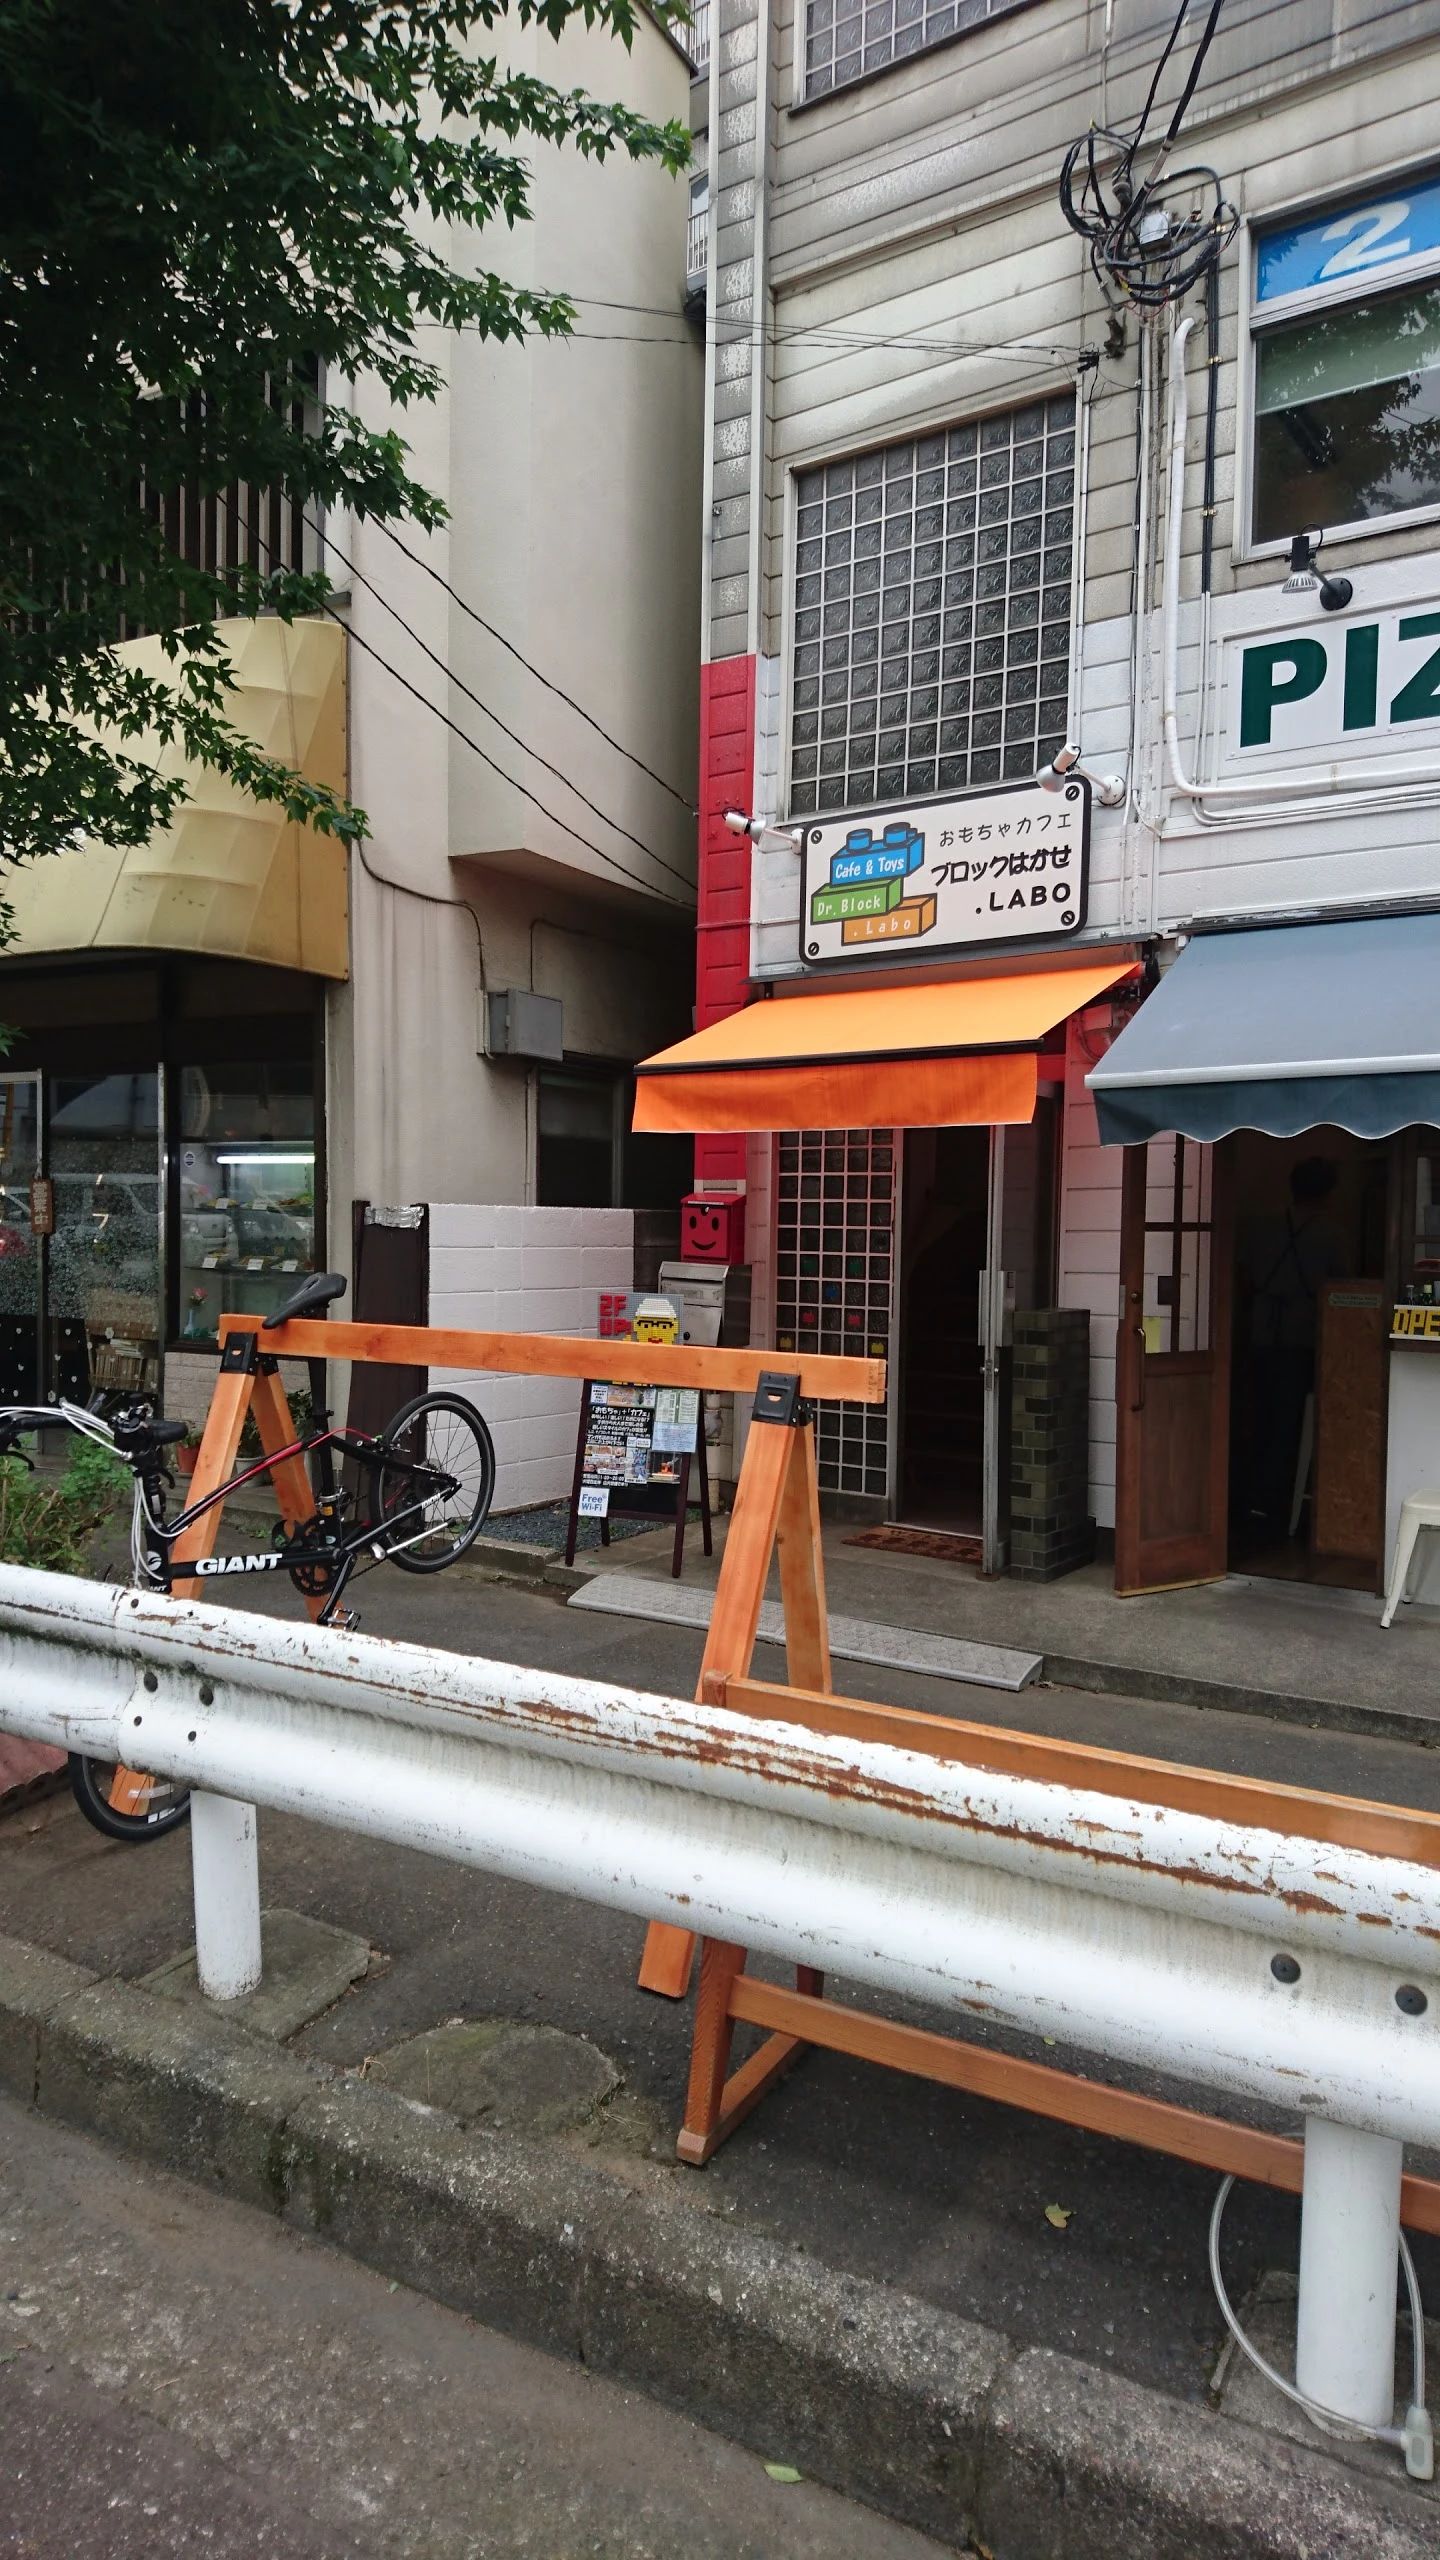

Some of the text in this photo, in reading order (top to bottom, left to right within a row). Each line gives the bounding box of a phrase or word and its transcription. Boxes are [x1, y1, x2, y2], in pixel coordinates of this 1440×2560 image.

[1320, 201, 1410, 278] 2
[939, 813, 1072, 847] おもちゃカフェ
[835, 856, 905, 879] Cafe & Toys
[930, 844, 1072, 887] ブロックはかせ
[817, 895, 881, 916] Dr. Block
[599, 1294, 627, 1316] 2F
[581, 1502, 603, 1512] Wi-Fi
[582, 1493, 603, 1504] Free
[195, 1553, 283, 1576] GIANT
